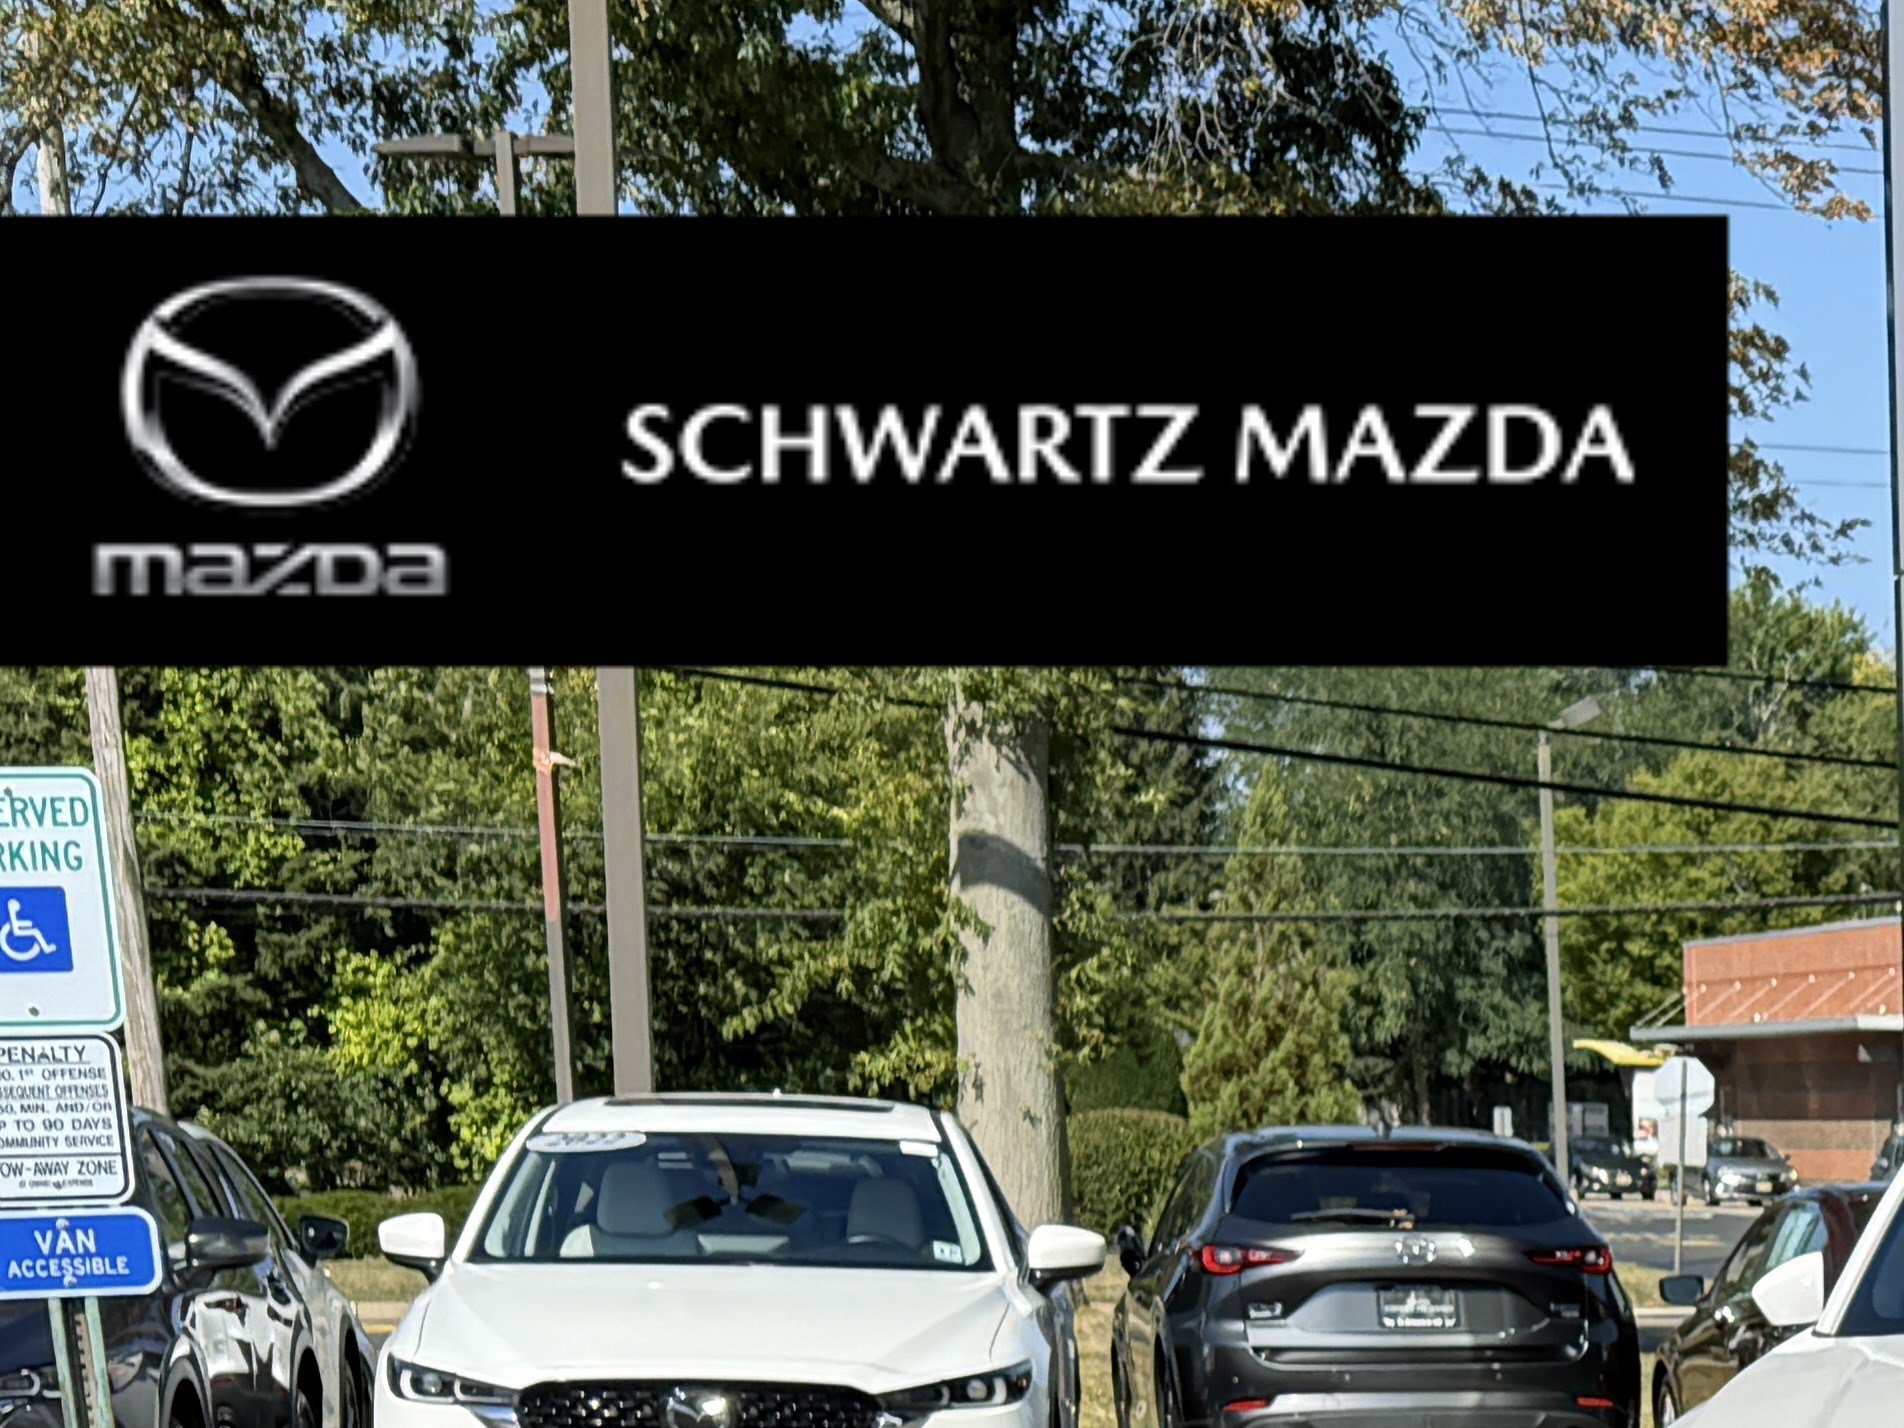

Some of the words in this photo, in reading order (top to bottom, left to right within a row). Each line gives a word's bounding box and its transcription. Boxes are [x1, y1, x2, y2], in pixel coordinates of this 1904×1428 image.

[42, 1067, 107, 1081] OFFENSE
[15, 1119, 35, 1132] TO
[71, 1117, 112, 1130] DAYS
[77, 1160, 118, 1176] ZONE
[33, 1228, 96, 1255] VAN
[8, 1256, 130, 1279] ACCESSIBLE
